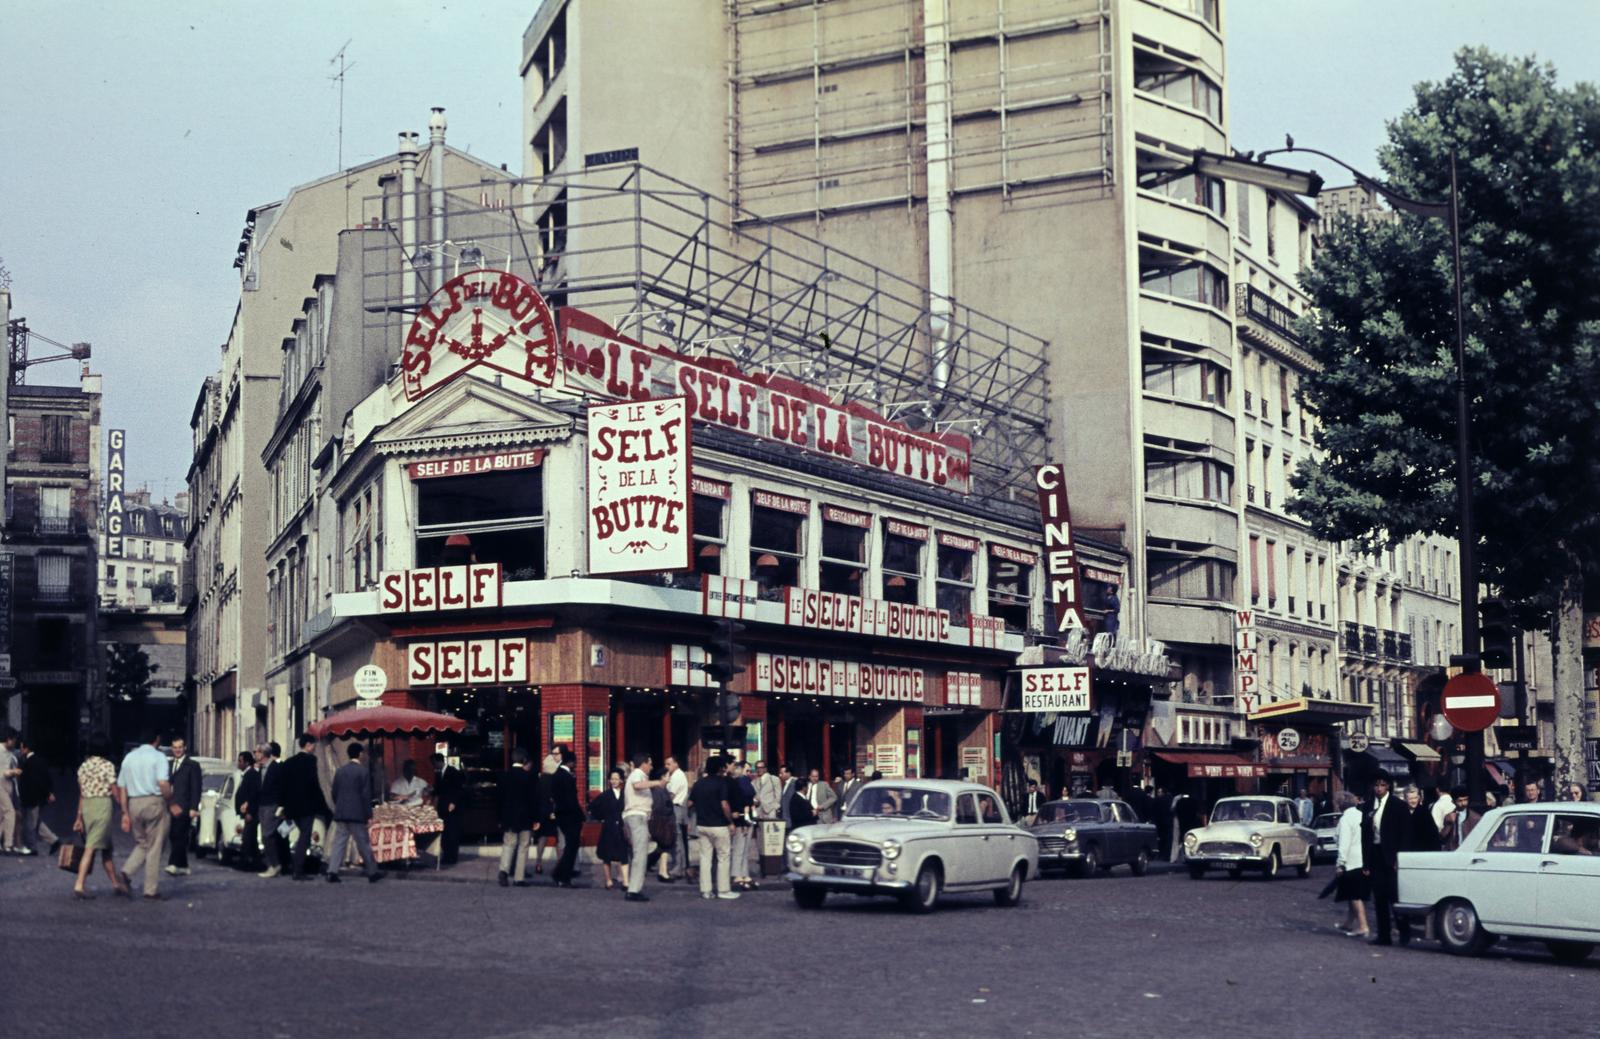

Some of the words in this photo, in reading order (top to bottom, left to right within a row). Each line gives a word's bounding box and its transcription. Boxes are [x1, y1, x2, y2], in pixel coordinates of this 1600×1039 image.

[463, 282, 480, 301] DE
[480, 281, 498, 297] LA
[403, 275, 464, 375] SELF
[492, 273, 556, 379] BUTTE
[407, 373, 422, 394] LE
[607, 343, 651, 399] LE
[679, 366, 756, 429] SELF
[771, 393, 807, 445] DE
[816, 408, 852, 458] LA
[868, 424, 947, 485] BUTTE
[628, 406, 645, 422] LE
[592, 417, 681, 463] SELF
[417, 462, 449, 476] SELF
[454, 459, 470, 473] DE
[475, 457, 491, 471] LA
[494, 452, 535, 468] BUTTE
[619, 471, 636, 487] DE
[640, 469, 657, 485] LA
[108, 431, 123, 556] GARAGE
[691, 479, 725, 496] STAURANT
[757, 493, 771, 506] SELF
[771, 495, 781, 508] DE
[781, 497, 790, 510] LA
[592, 495, 684, 540] BUTTE
[829, 508, 867, 526] RESTAURANT
[1036, 465, 1084, 632] CINEMA
[383, 568, 495, 609] SELF
[791, 599, 801, 613] LE
[806, 593, 860, 628] SELF
[864, 609, 873, 623] DE
[877, 611, 886, 625] LA
[890, 605, 949, 639] BUTTE
[411, 643, 524, 681] SELF
[759, 665, 769, 679] LE
[774, 657, 830, 691] SELF
[834, 672, 844, 685] DE
[849, 673, 858, 687] LA
[861, 666, 922, 698] BUTTE
[1237, 611, 1254, 713] WIMPY
[1025, 673, 1087, 692] SELF
[1025, 694, 1087, 708] RESTAURANT
[1053, 716, 1091, 745] VIVANT
